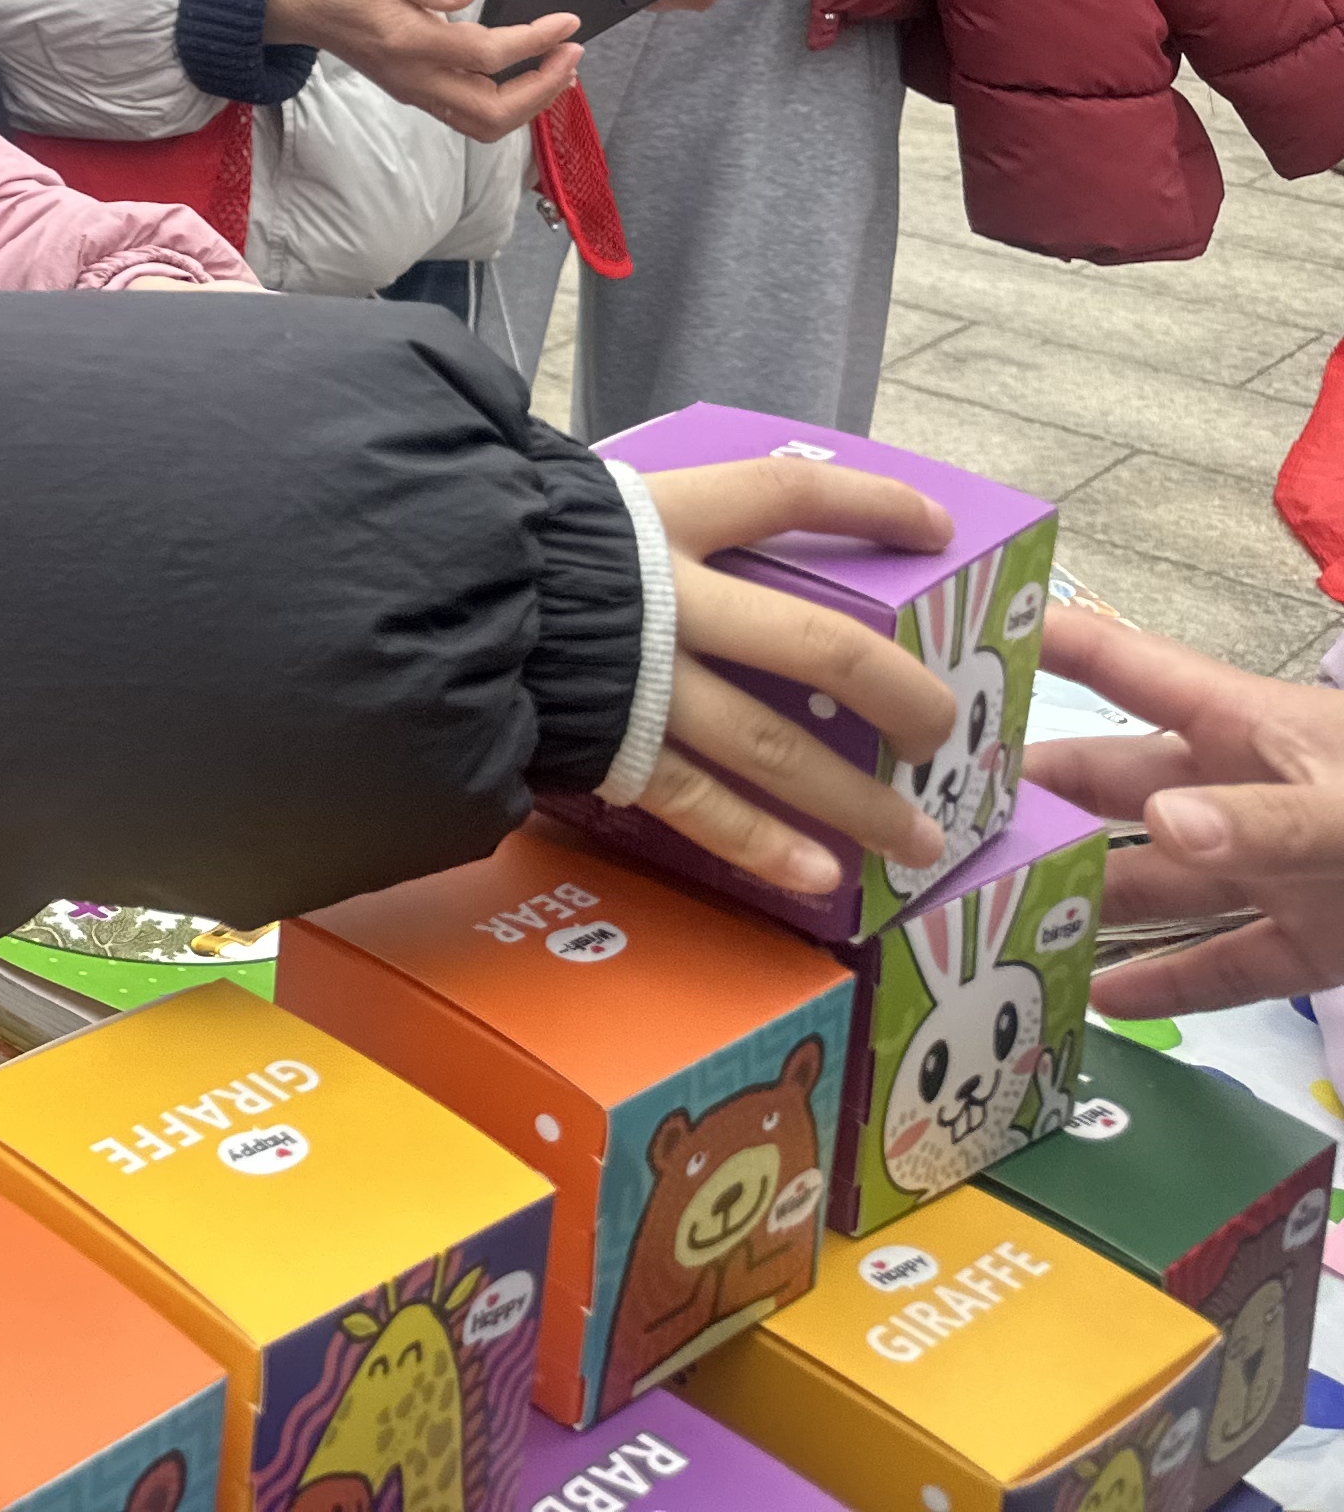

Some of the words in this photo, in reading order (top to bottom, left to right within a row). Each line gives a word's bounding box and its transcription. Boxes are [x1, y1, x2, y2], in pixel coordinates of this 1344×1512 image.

[472, 882, 601, 943] BEAR
[89, 1059, 321, 1175] GIRAFFE
[227, 1130, 299, 1162] Happy
[870, 1254, 930, 1285] Happy
[470, 1292, 527, 1334] Happy
[866, 1241, 1052, 1363] GIRAFFE
[531, 1432, 690, 1512] RAB
